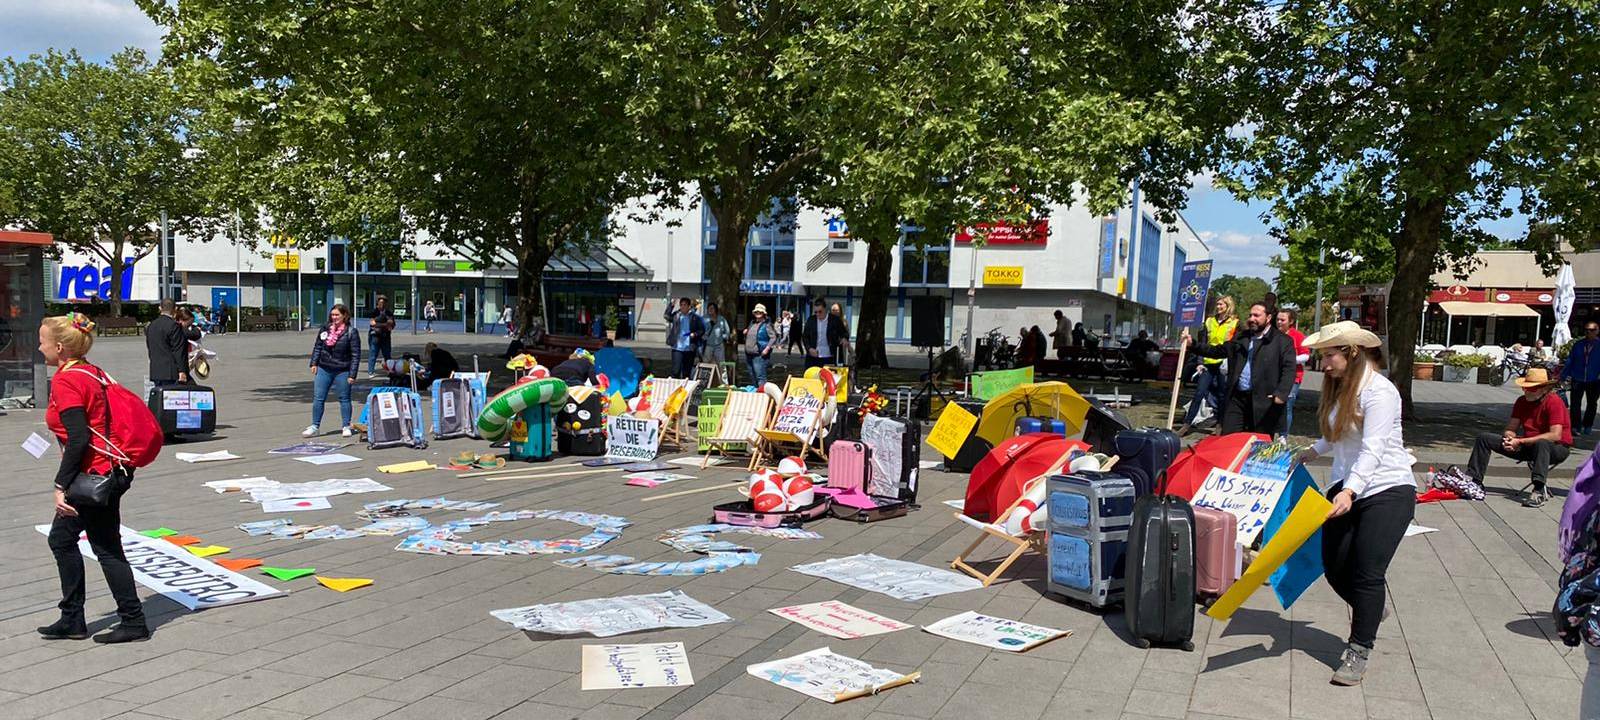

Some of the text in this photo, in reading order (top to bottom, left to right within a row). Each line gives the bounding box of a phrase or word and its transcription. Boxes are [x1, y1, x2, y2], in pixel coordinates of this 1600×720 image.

[740, 281, 793, 293] olksbank
[616, 418, 647, 432] RETTET
[625, 433, 640, 446] DIE
[608, 444, 657, 459] REISEBÜROS
[1250, 499, 1270, 514] bis
[123, 541, 257, 603] EISEBÜRO
